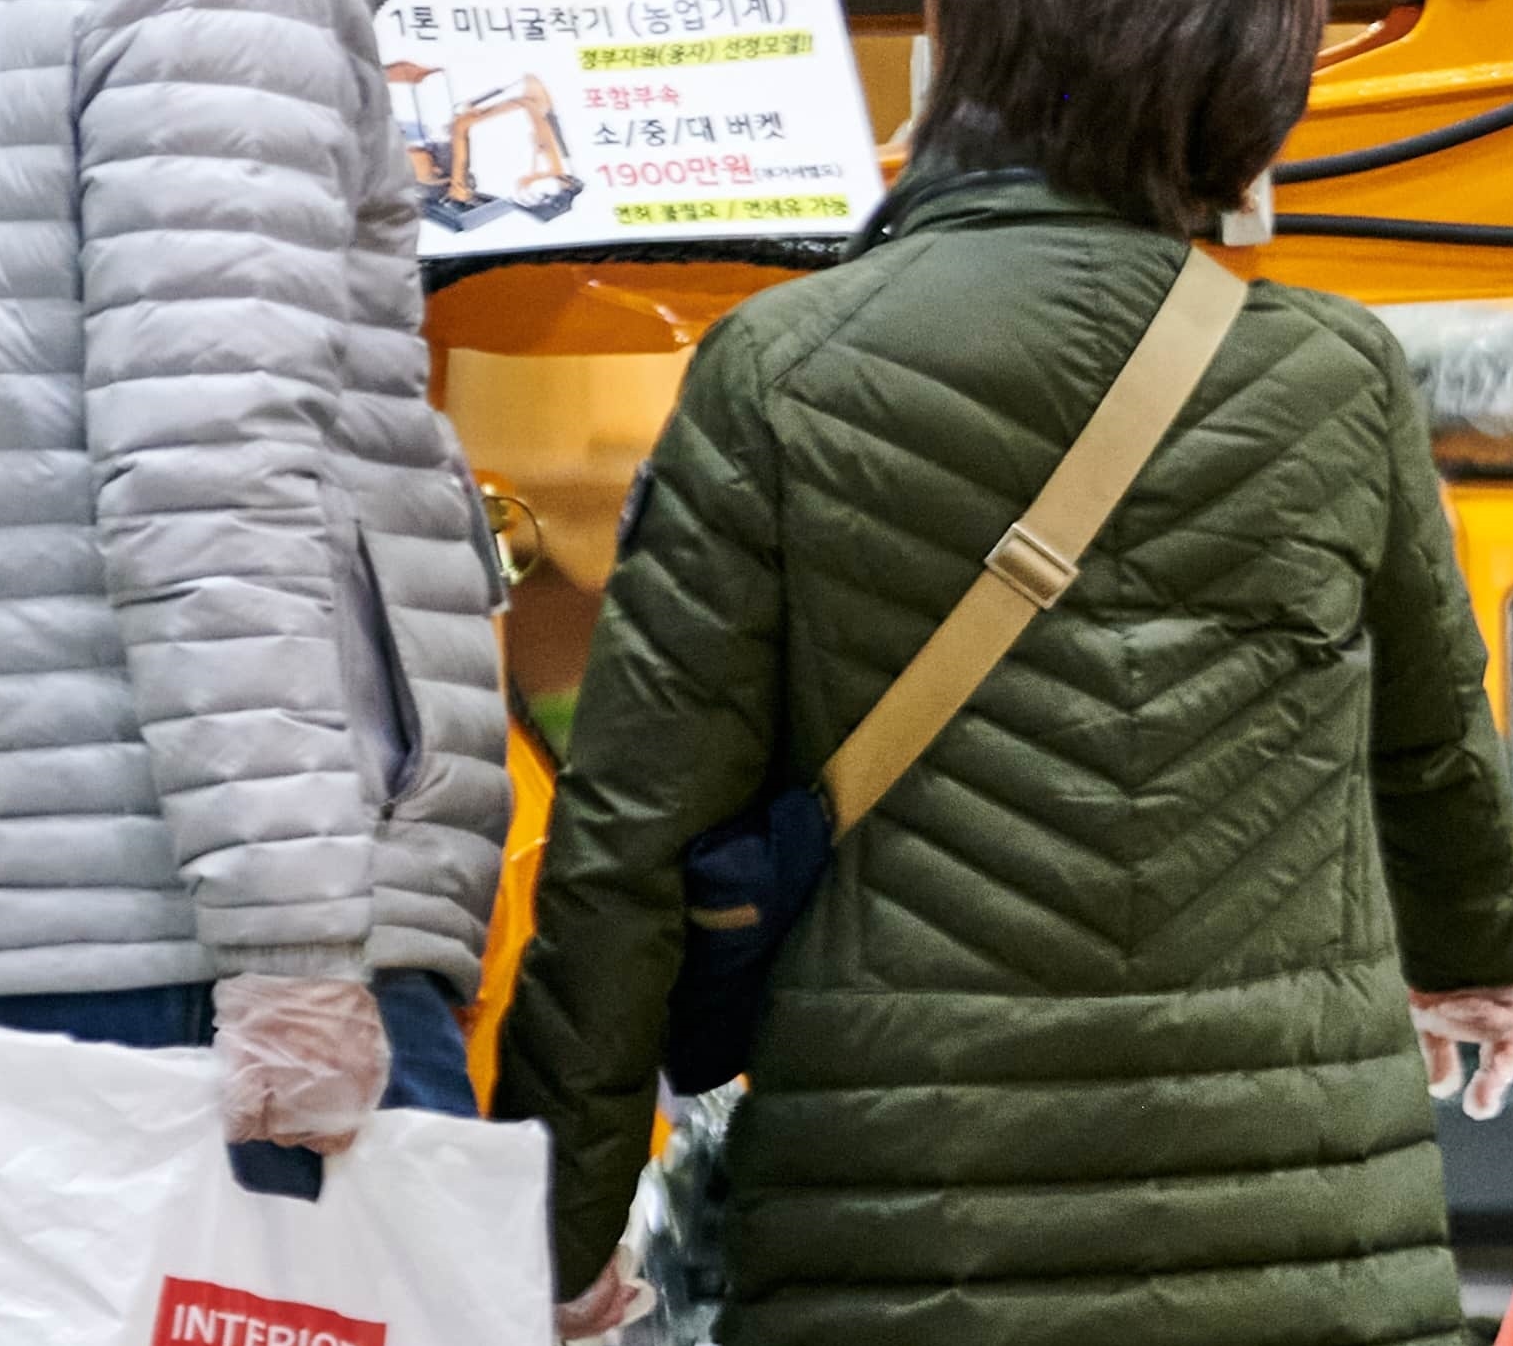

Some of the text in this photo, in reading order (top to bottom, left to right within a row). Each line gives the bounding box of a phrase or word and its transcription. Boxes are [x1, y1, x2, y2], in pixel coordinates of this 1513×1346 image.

[390, 7, 439, 42] 1톤
[453, 4, 617, 42] 미니굴착기
[584, 85, 680, 111] 포함부속
[594, 111, 786, 147] 소/중/대 버켓
[812, 195, 848, 216] 가능
